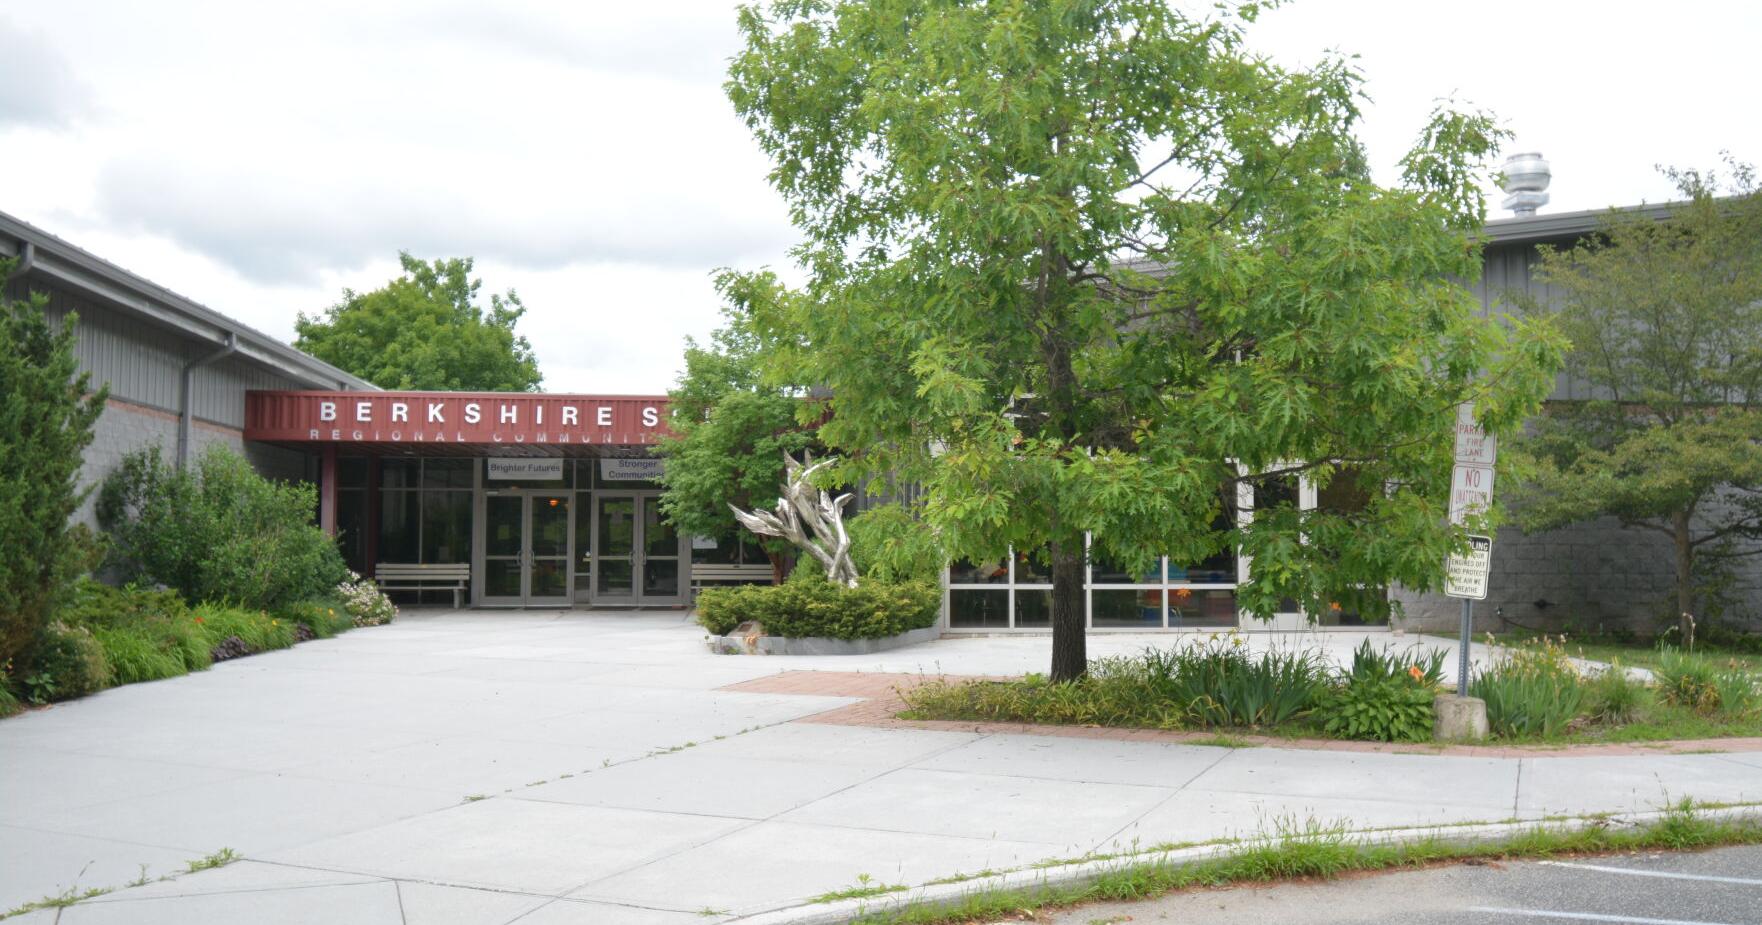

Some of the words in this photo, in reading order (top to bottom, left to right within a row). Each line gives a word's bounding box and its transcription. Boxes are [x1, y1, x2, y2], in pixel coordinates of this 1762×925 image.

[319, 401, 613, 427] BERKSHIRE
[310, 429, 465, 442] REGIONAL
[493, 432, 668, 444] COMMUNIT
[1466, 437, 1485, 448] FIRE
[1465, 447, 1484, 457] LANE
[490, 463, 526, 473] Brighter
[528, 463, 561, 473] Futures
[618, 459, 657, 469] Stronger
[1465, 468, 1481, 488] NO
[1465, 540, 1489, 551] DLING
[1451, 559, 1474, 567] ENGINES
[1475, 561, 1486, 569] OFF
[1449, 567, 1461, 575] AND
[1462, 568, 1487, 577] PROTECT
[1464, 577, 1473, 585] AIR
[1473, 578, 1481, 586] WE
[1454, 585, 1479, 594] BREATHE
